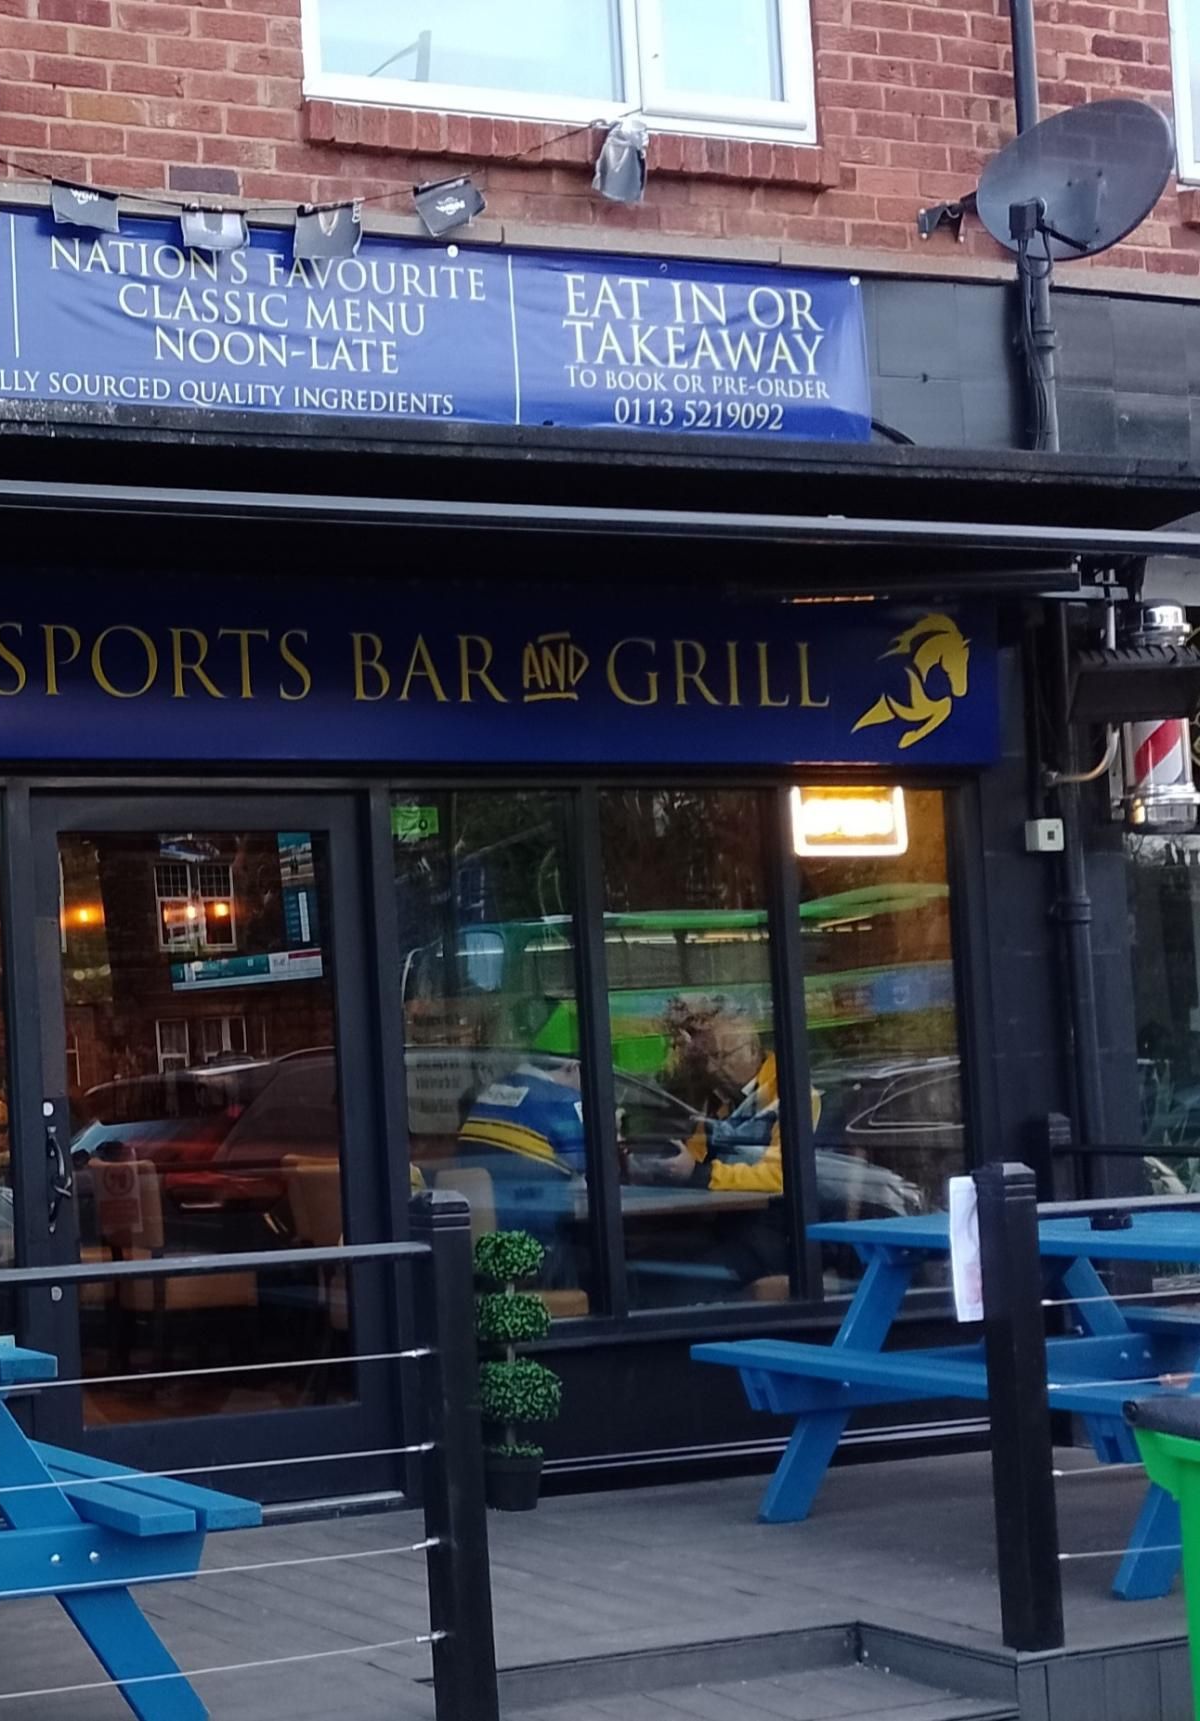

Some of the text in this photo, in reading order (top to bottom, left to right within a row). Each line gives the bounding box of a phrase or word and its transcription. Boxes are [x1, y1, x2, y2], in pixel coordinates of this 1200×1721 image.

[267, 253, 486, 300] FAVOURITE
[117, 284, 426, 337] CLASSIC MENU
[563, 274, 824, 332] EAT IN OR
[154, 327, 399, 375] NOON-LATE
[561, 320, 824, 376] TAKEAWAY
[49, 371, 171, 399] SOURCED
[179, 380, 284, 409] QUALITY
[293, 386, 454, 415] INGREDIENTS
[564, 365, 830, 400] TO BOOK OR PRE-ORDER
[614, 396, 784, 431] 0113 5219092
[349, 632, 508, 703] BAR
[522, 638, 589, 695] AND
[606, 638, 831, 709] GRILL
